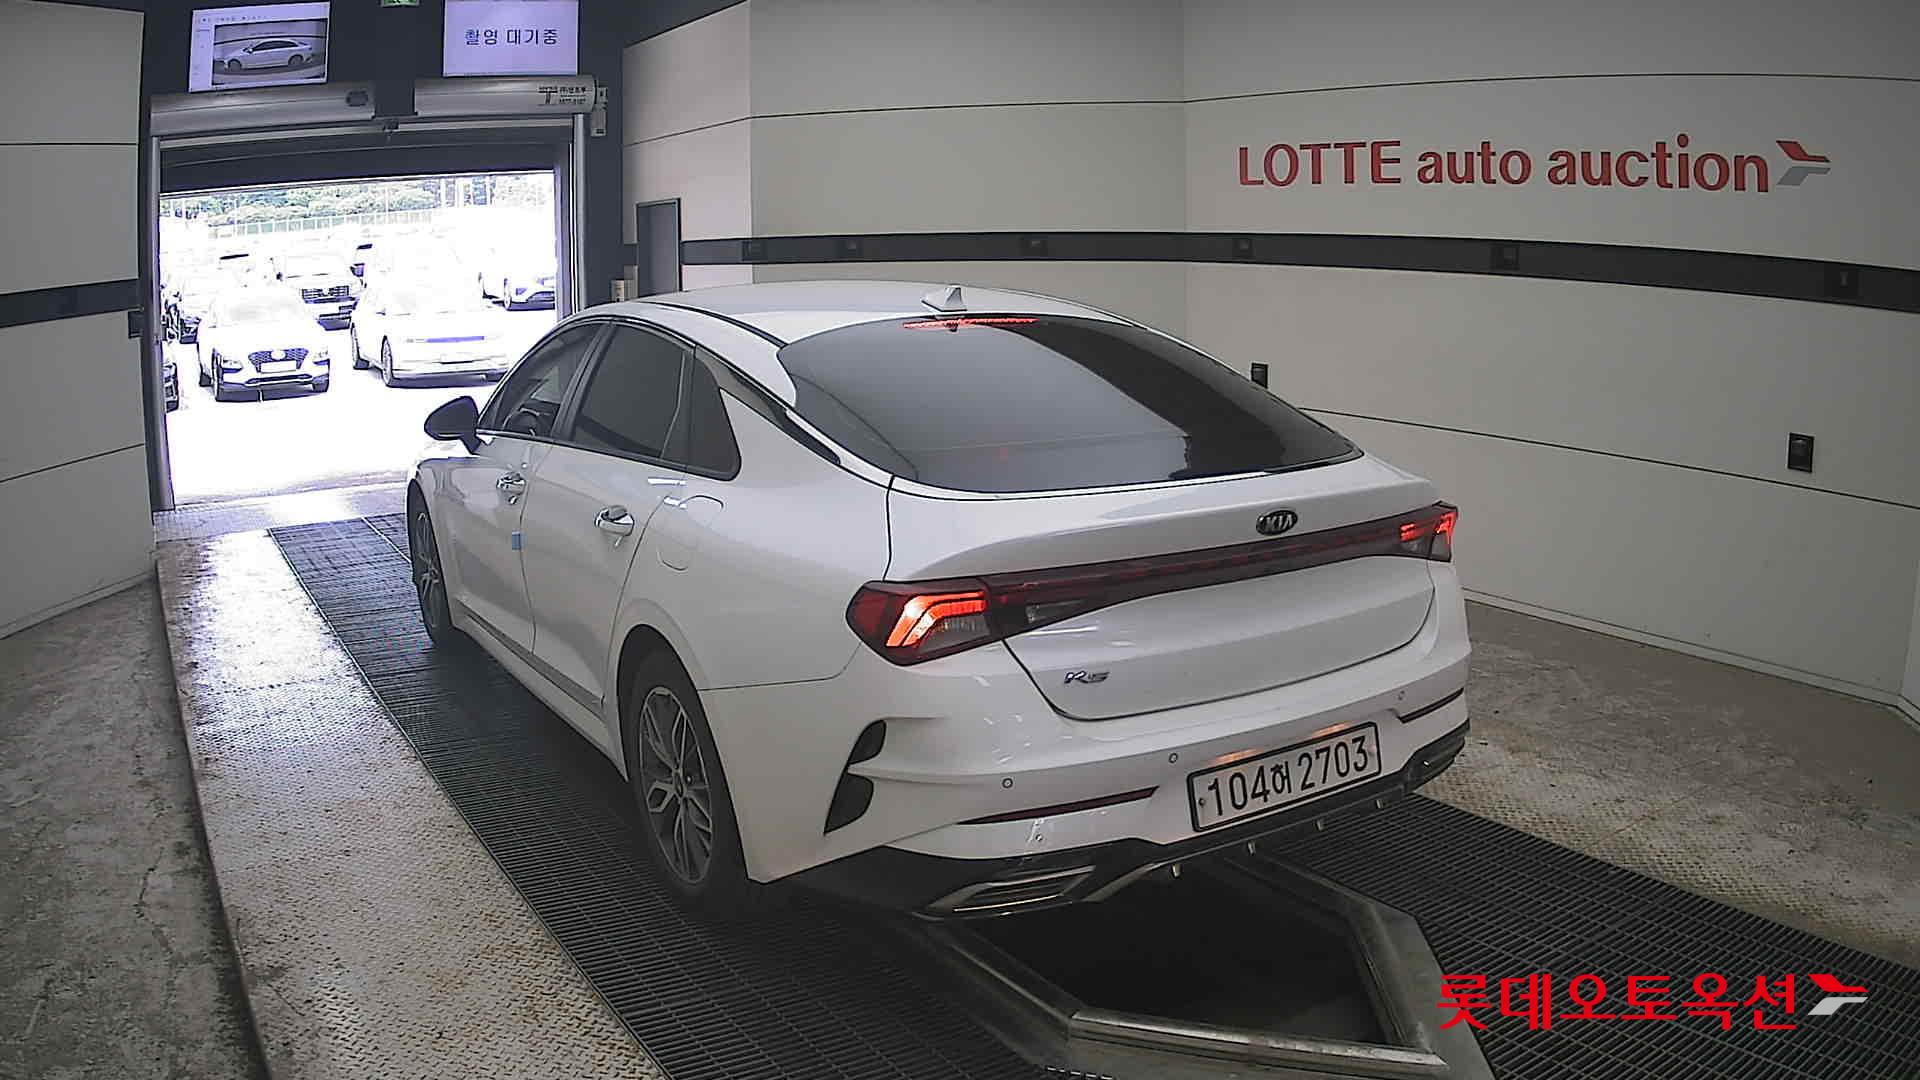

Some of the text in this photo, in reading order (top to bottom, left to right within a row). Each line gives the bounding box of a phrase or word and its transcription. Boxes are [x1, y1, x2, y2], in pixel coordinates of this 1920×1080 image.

[465, 29, 558, 45] 촬영 대기중
[1238, 133, 1769, 192] LOTTE auto auction
[1262, 512, 1295, 532] KIA
[1207, 735, 1369, 817] 104허 2703
